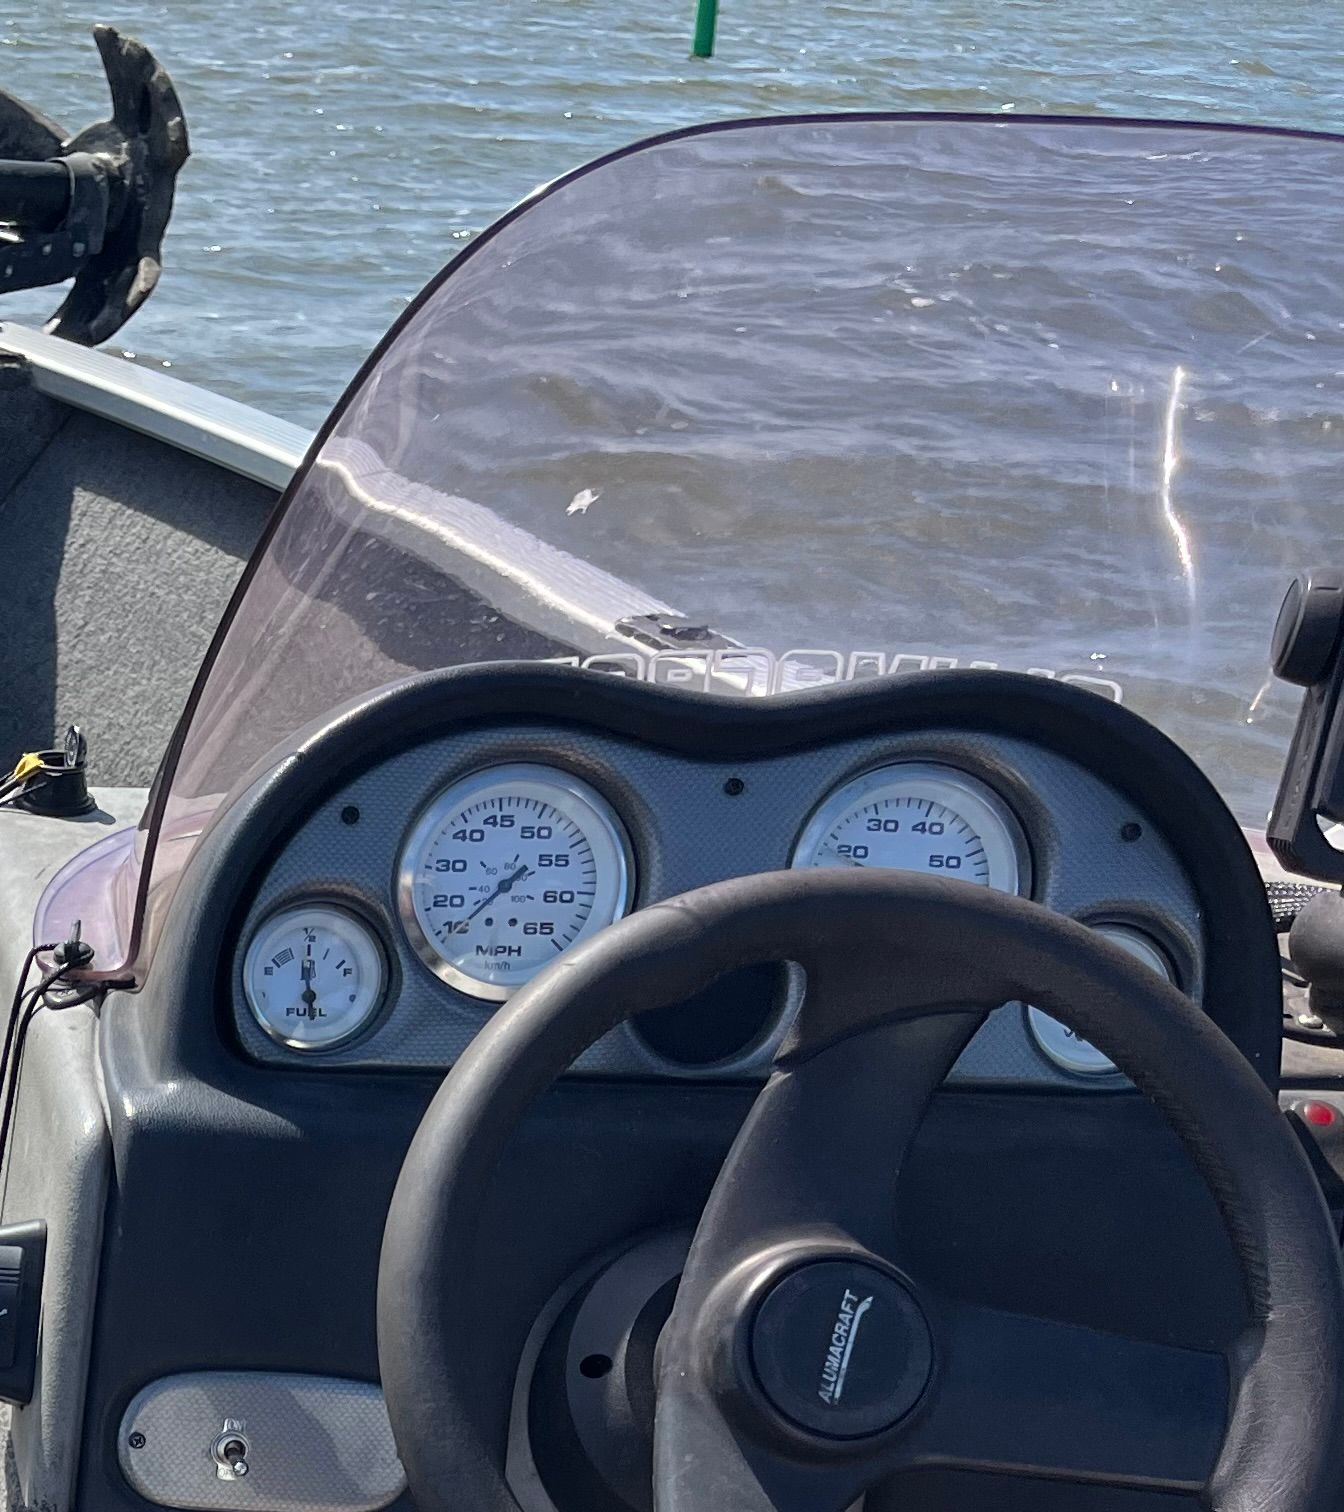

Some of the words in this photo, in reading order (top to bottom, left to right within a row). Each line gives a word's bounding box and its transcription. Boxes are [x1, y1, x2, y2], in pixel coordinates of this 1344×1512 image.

[483, 815, 515, 828] 45
[867, 819, 898, 833] 30
[912, 821, 944, 835] 40
[452, 829, 485, 842] 40
[520, 826, 552, 839] 50
[837, 845, 869, 858] 20
[435, 860, 467, 872] 30
[538, 854, 569, 867] 55
[929, 855, 961, 869] 50
[433, 895, 465, 907] 20
[543, 891, 575, 904] 60
[523, 922, 554, 935] 65
[476, 945, 521, 957] MPH
[264, 967, 273, 976] E
[343, 968, 352, 977] F
[818, 1288, 859, 1405] ALUMACRAFT
